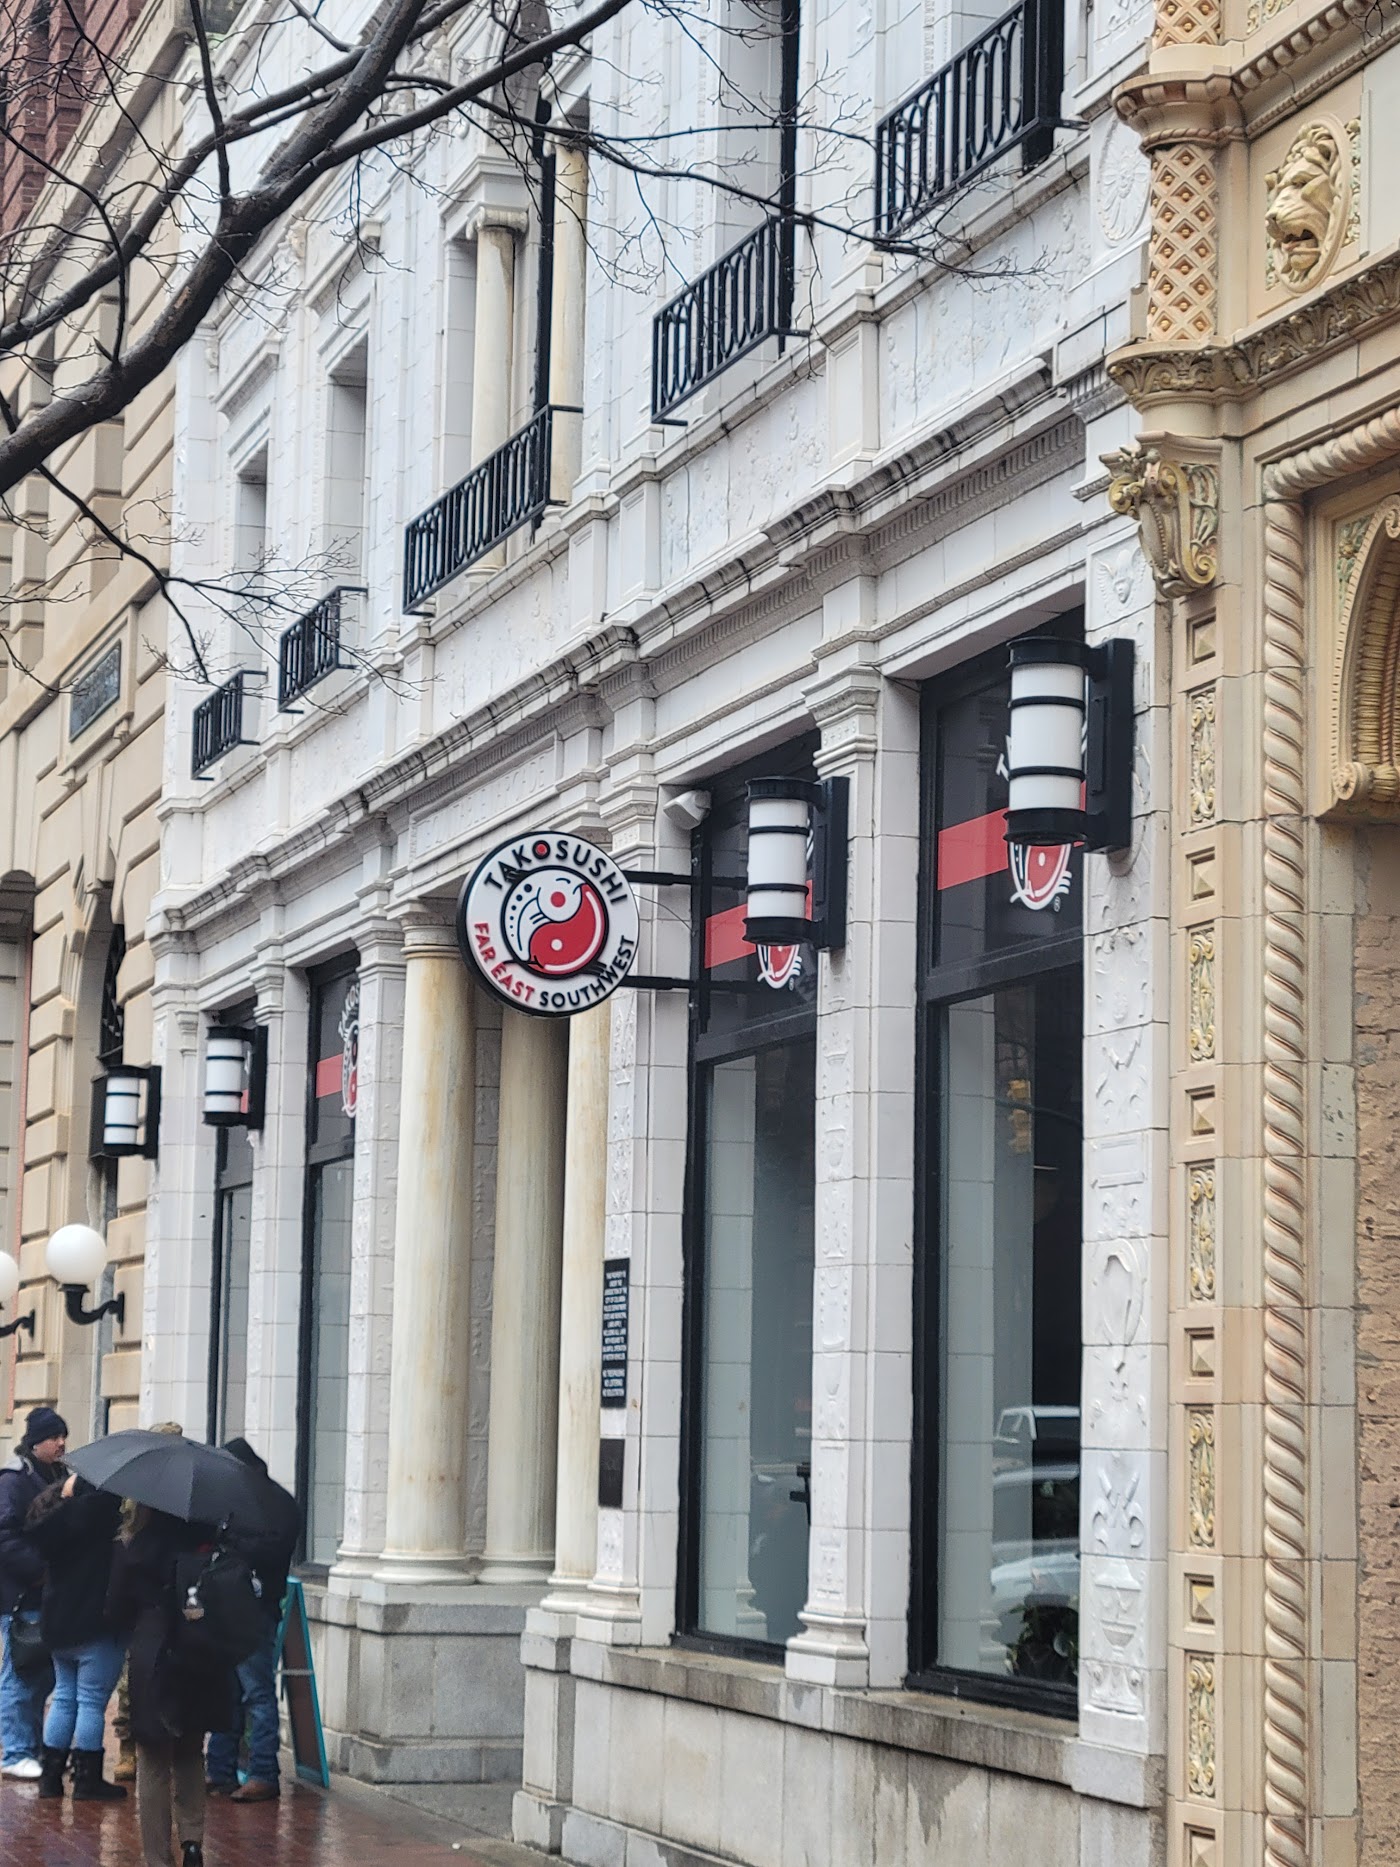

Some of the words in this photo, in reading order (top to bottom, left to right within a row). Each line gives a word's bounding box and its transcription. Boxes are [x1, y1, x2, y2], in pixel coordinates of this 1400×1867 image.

[474, 922, 496, 963] FAR
[491, 962, 535, 1002] EAST
[539, 935, 635, 1008] SOUTHWEST
